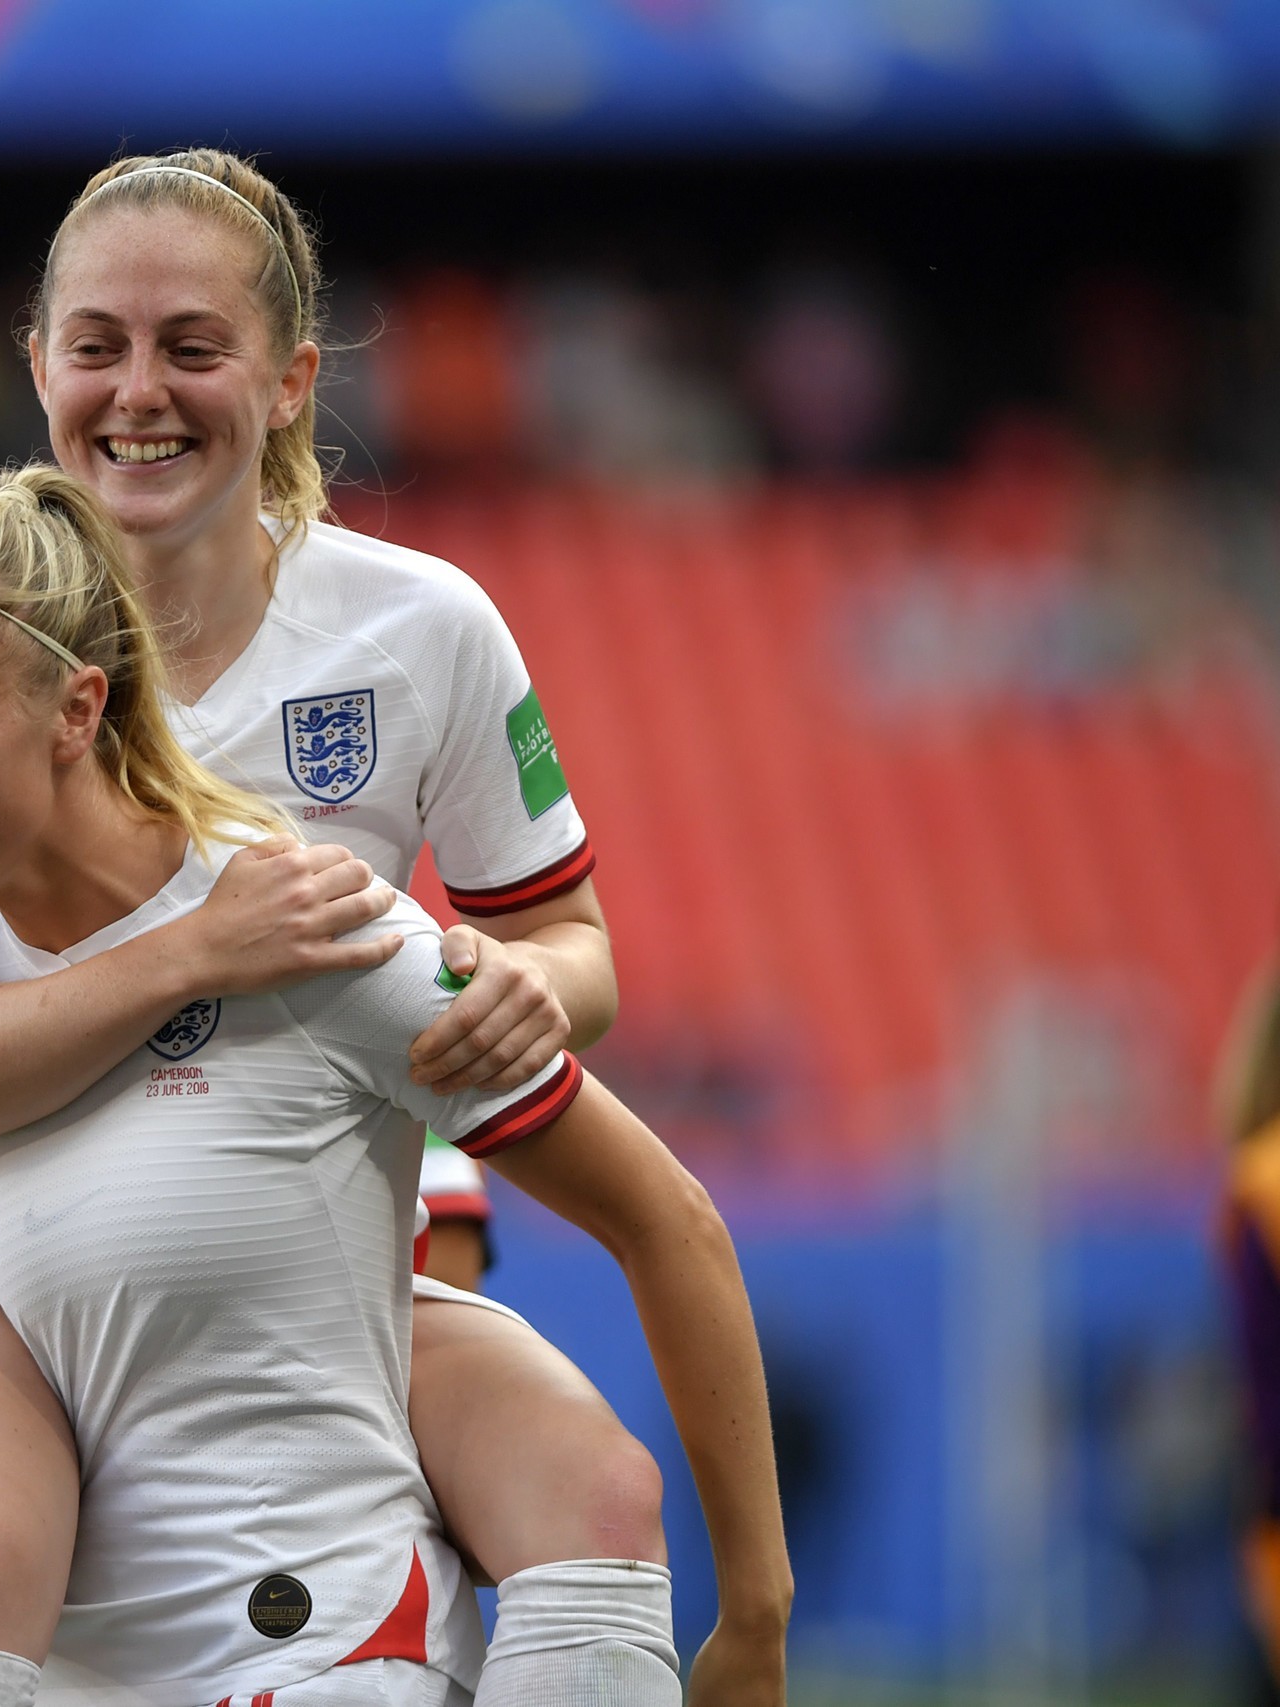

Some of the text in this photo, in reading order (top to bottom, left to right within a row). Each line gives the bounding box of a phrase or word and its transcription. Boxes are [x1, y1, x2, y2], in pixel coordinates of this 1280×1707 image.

[302, 806, 316, 820] 23
[150, 1066, 204, 1081] CAMEROON
[146, 1081, 209, 1097] 23 JUNE 2019
